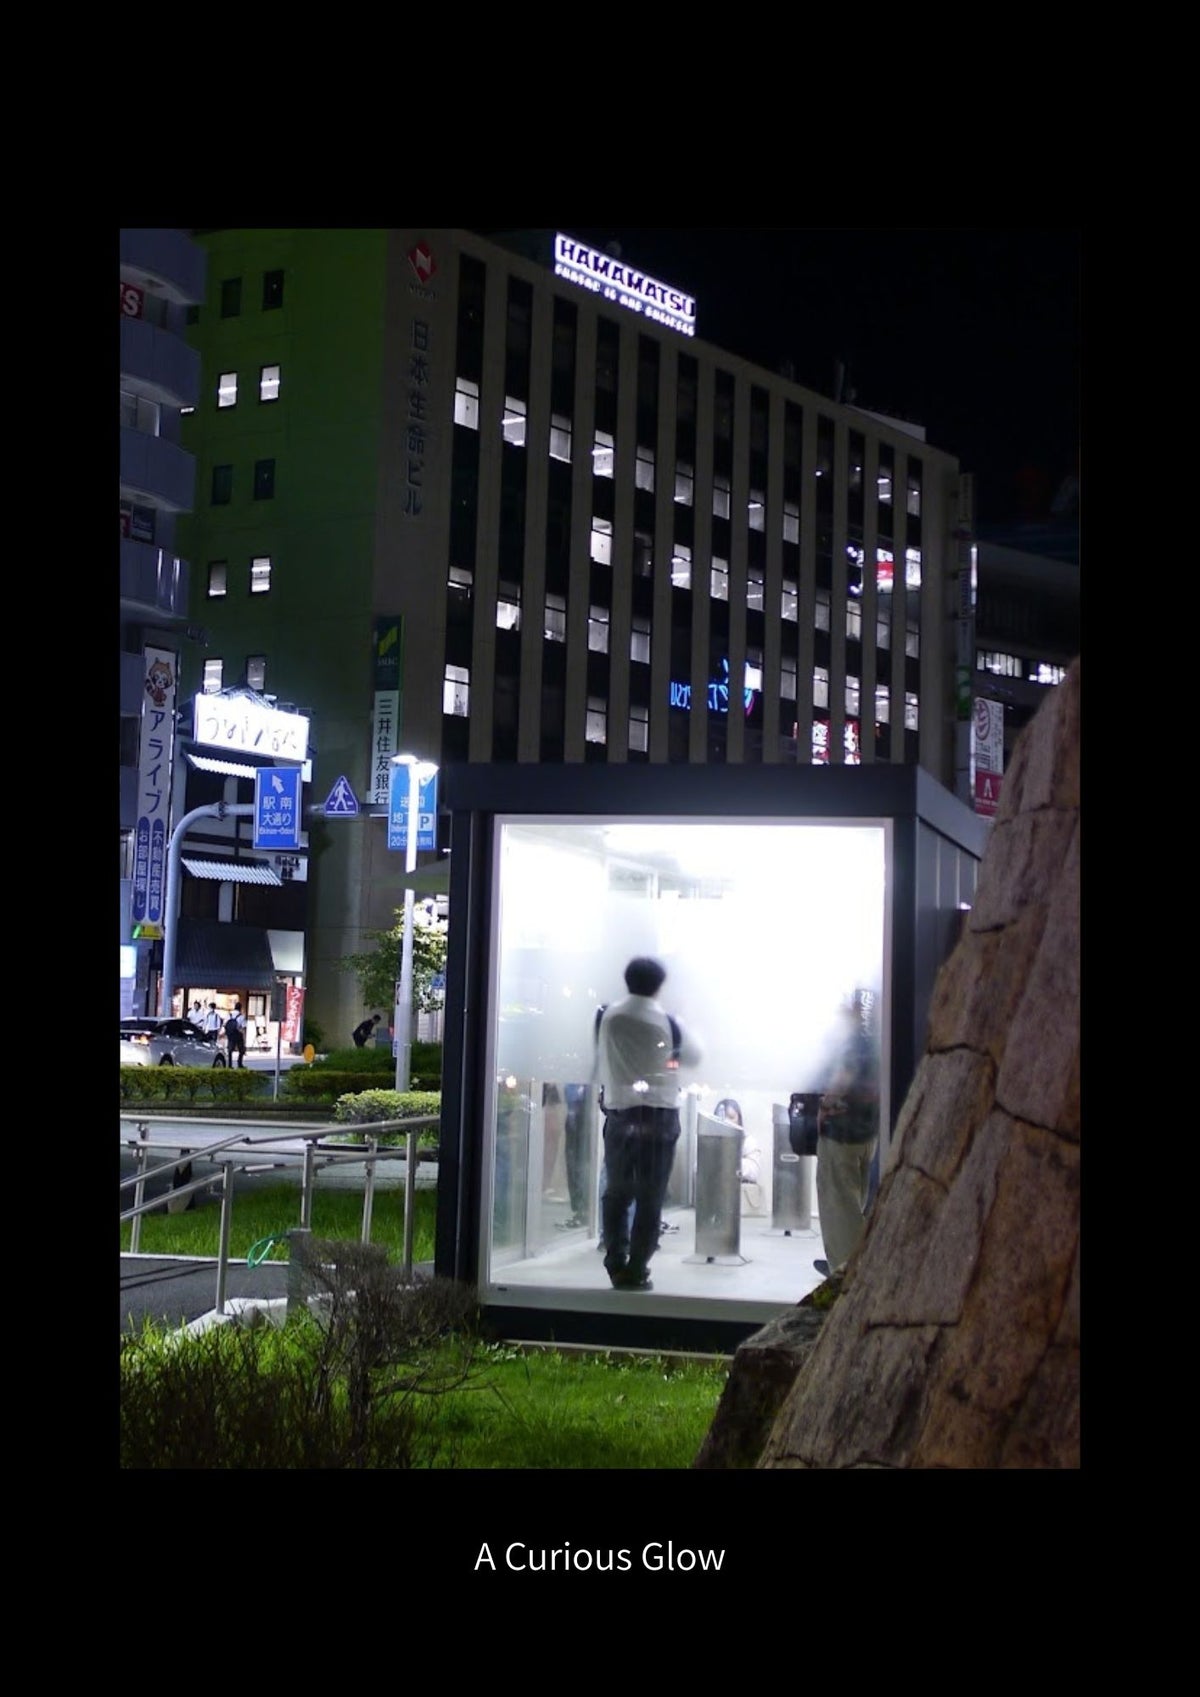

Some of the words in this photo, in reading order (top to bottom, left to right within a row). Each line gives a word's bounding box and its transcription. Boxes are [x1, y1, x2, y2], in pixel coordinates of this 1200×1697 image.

[560, 239, 696, 317] HAMAMATSU
[145, 709, 166, 814] アライブ
[375, 698, 393, 805] 三井住友銀行
[263, 796, 293, 810] 駅南
[263, 812, 292, 826] 大通り
